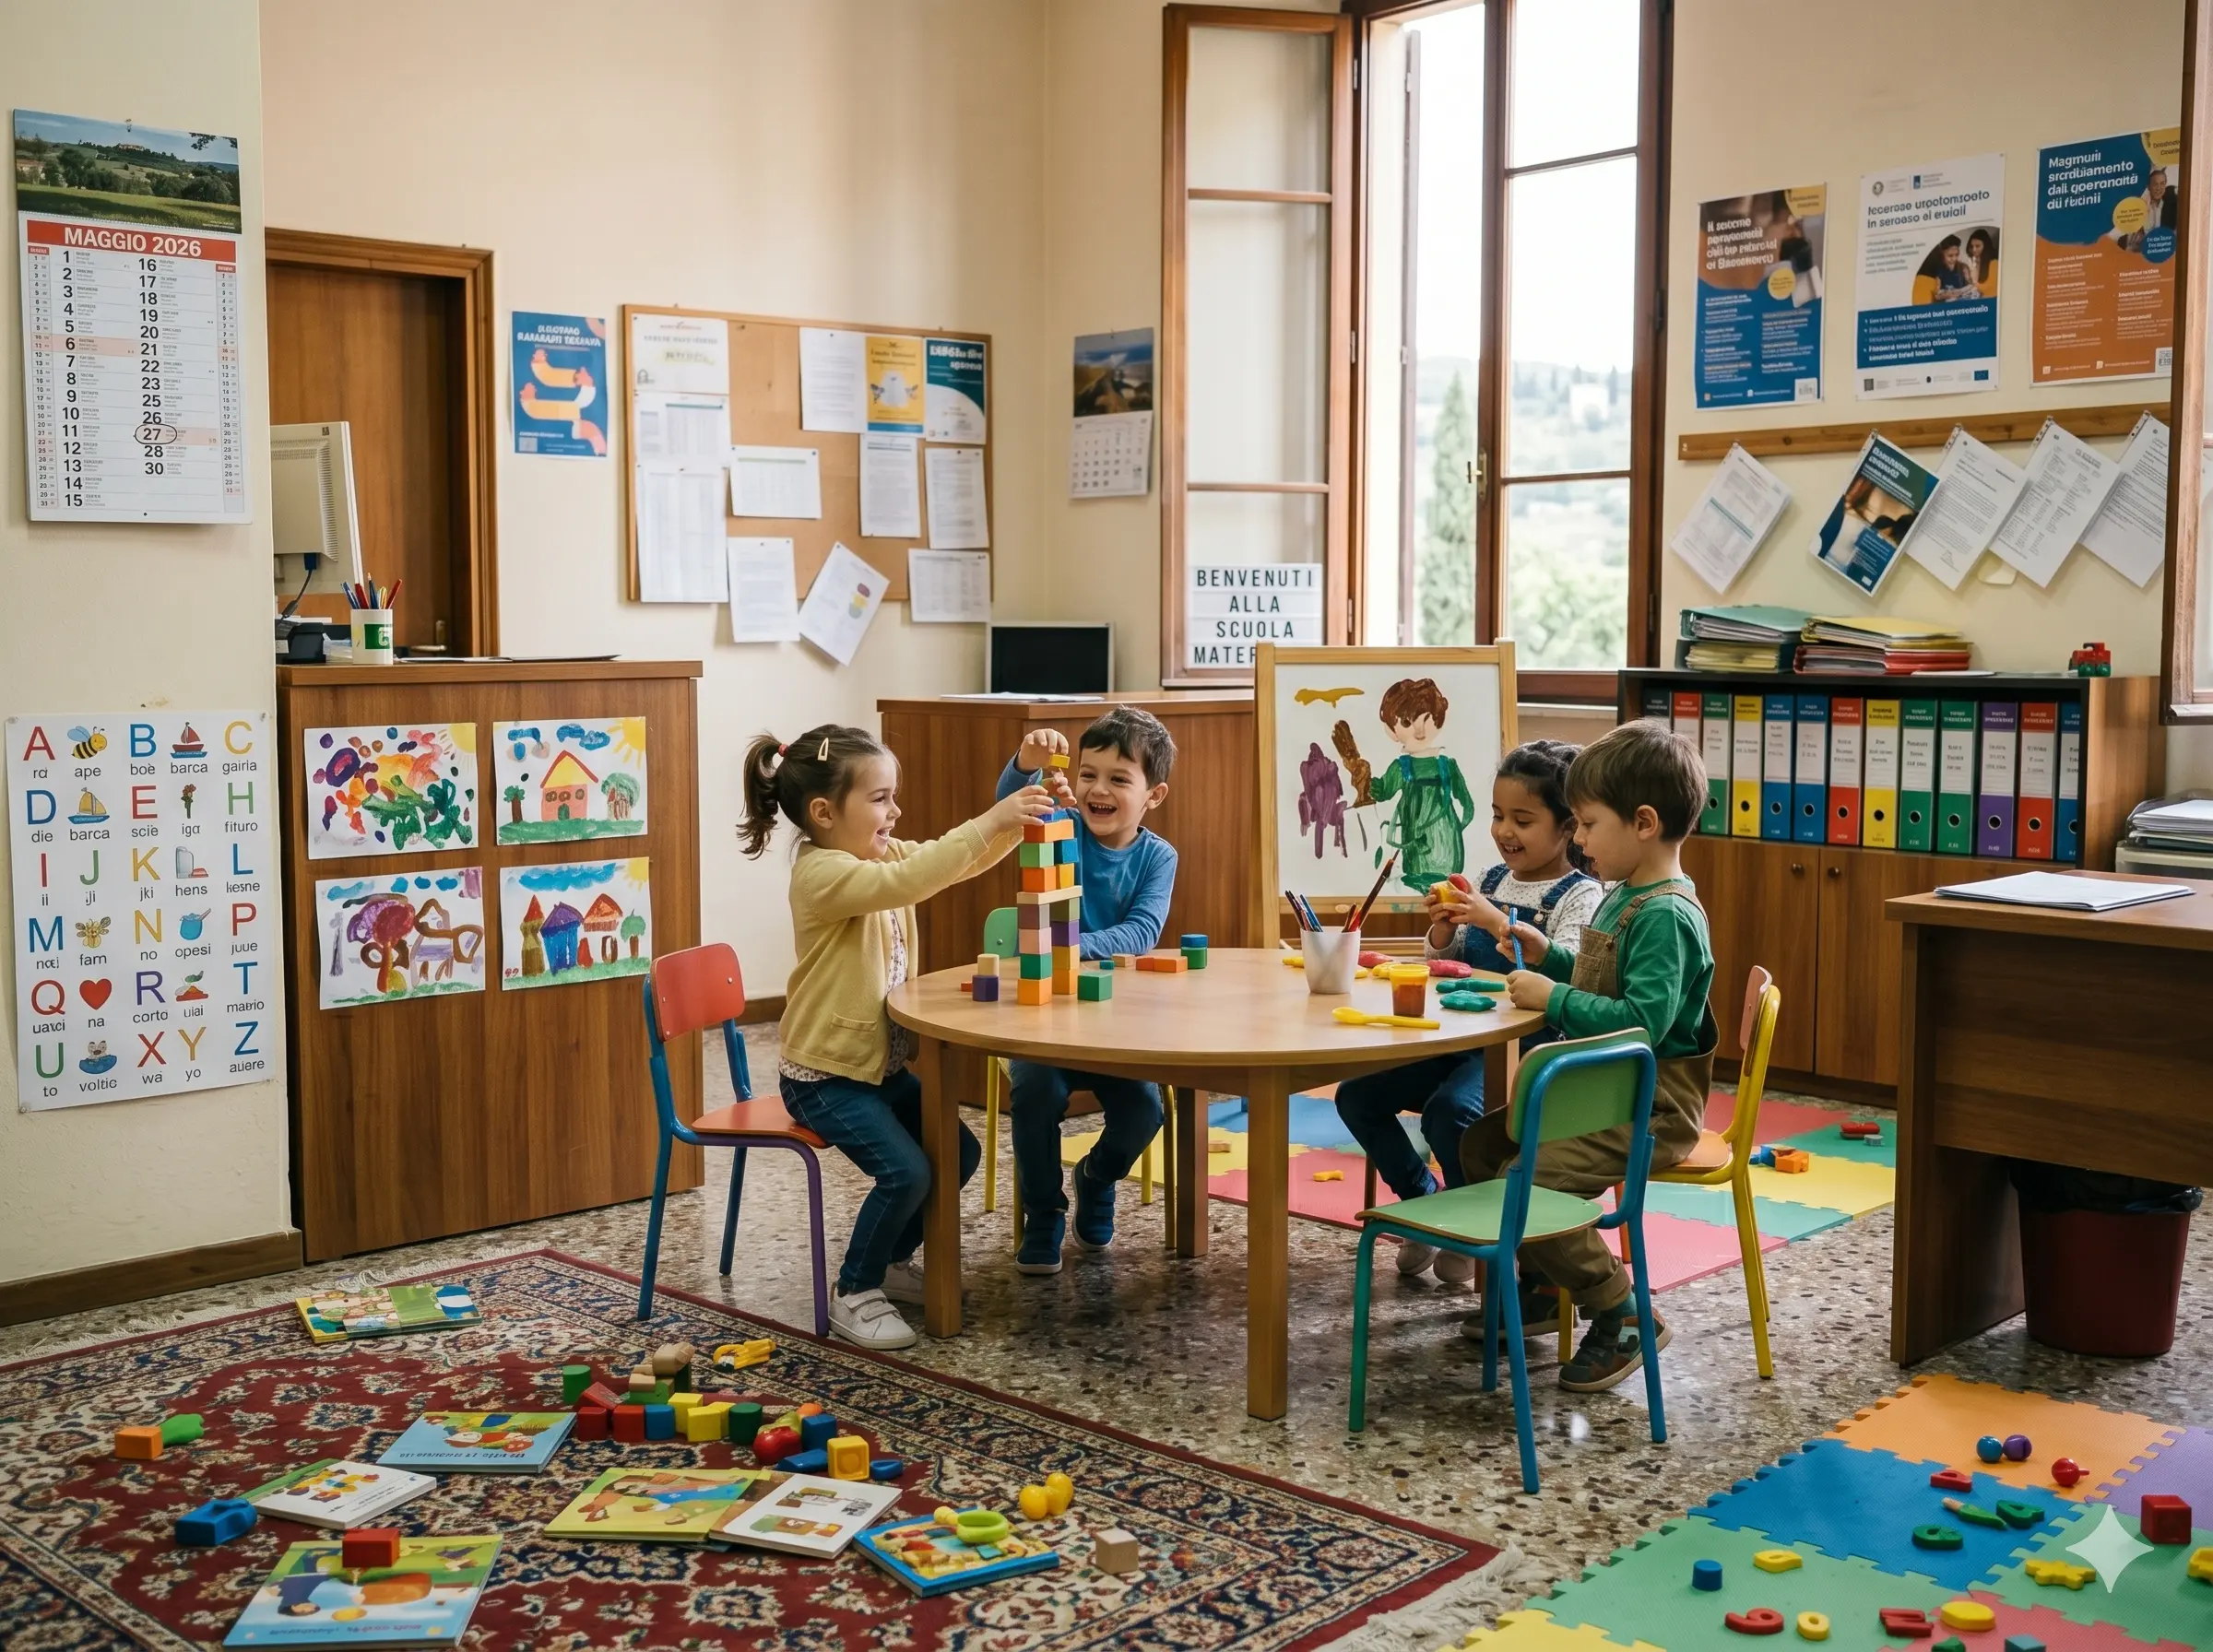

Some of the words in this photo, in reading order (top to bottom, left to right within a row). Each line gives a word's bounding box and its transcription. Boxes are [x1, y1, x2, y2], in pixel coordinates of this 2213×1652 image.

[65, 227, 147, 252] MAGGIO
[152, 236, 202, 257] 2026
[64, 251, 69, 263] 1
[139, 258, 157, 271] 16
[63, 267, 72, 280] 2
[139, 275, 157, 288] 17
[64, 286, 73, 298] 3
[139, 292, 158, 305] 18
[64, 303, 74, 315] 4
[140, 309, 158, 322] 19
[65, 320, 74, 332] 5
[140, 325, 159, 339] 20
[65, 337, 75, 350] 6
[141, 343, 157, 356] 21
[66, 355, 75, 367] 7
[141, 360, 160, 372] 22
[66, 372, 76, 385] 8
[142, 377, 160, 390] 23
[66, 390, 76, 402] 9
[142, 395, 160, 407] 25
[63, 407, 79, 420] 10
[143, 411, 161, 424] 26
[63, 424, 77, 437] 11
[143, 428, 161, 441] 27
[64, 442, 81, 454] 12
[144, 445, 163, 457] 28
[64, 459, 81, 472] 13
[145, 462, 163, 475] 30
[65, 477, 82, 490] 14
[65, 494, 83, 507] 15
[1197, 570, 1311, 586] BENVENUTI
[1229, 596, 1280, 612] ALLA
[1216, 621, 1294, 638] SCUOLA
[23, 726, 55, 761] A
[129, 723, 157, 758] B
[225, 720, 253, 755] C
[75, 767, 101, 780] ape
[171, 762, 208, 773] barca
[132, 785, 158, 819] E
[228, 782, 254, 815] H
[27, 789, 56, 825] D
[31, 830, 53, 843] die
[70, 829, 110, 841] barca
[133, 847, 160, 881] K
[233, 844, 254, 875] L
[41, 853, 48, 887] I
[80, 850, 100, 885] J
[140, 887, 153, 902] jki
[175, 885, 207, 896] hens
[232, 903, 256, 936] P
[135, 909, 162, 944] N
[30, 915, 64, 953] M
[140, 950, 157, 961] no
[175, 943, 211, 960] opesi
[233, 962, 258, 995] T
[136, 971, 166, 1006] R
[31, 980, 65, 1015] Q
[89, 1018, 104, 1028] na
[178, 1027, 207, 1061] Y
[234, 1021, 259, 1056] Z
[137, 1031, 167, 1068] X
[36, 1043, 64, 1079] U
[185, 1068, 201, 1081] yo
[43, 1086, 57, 1097] to
